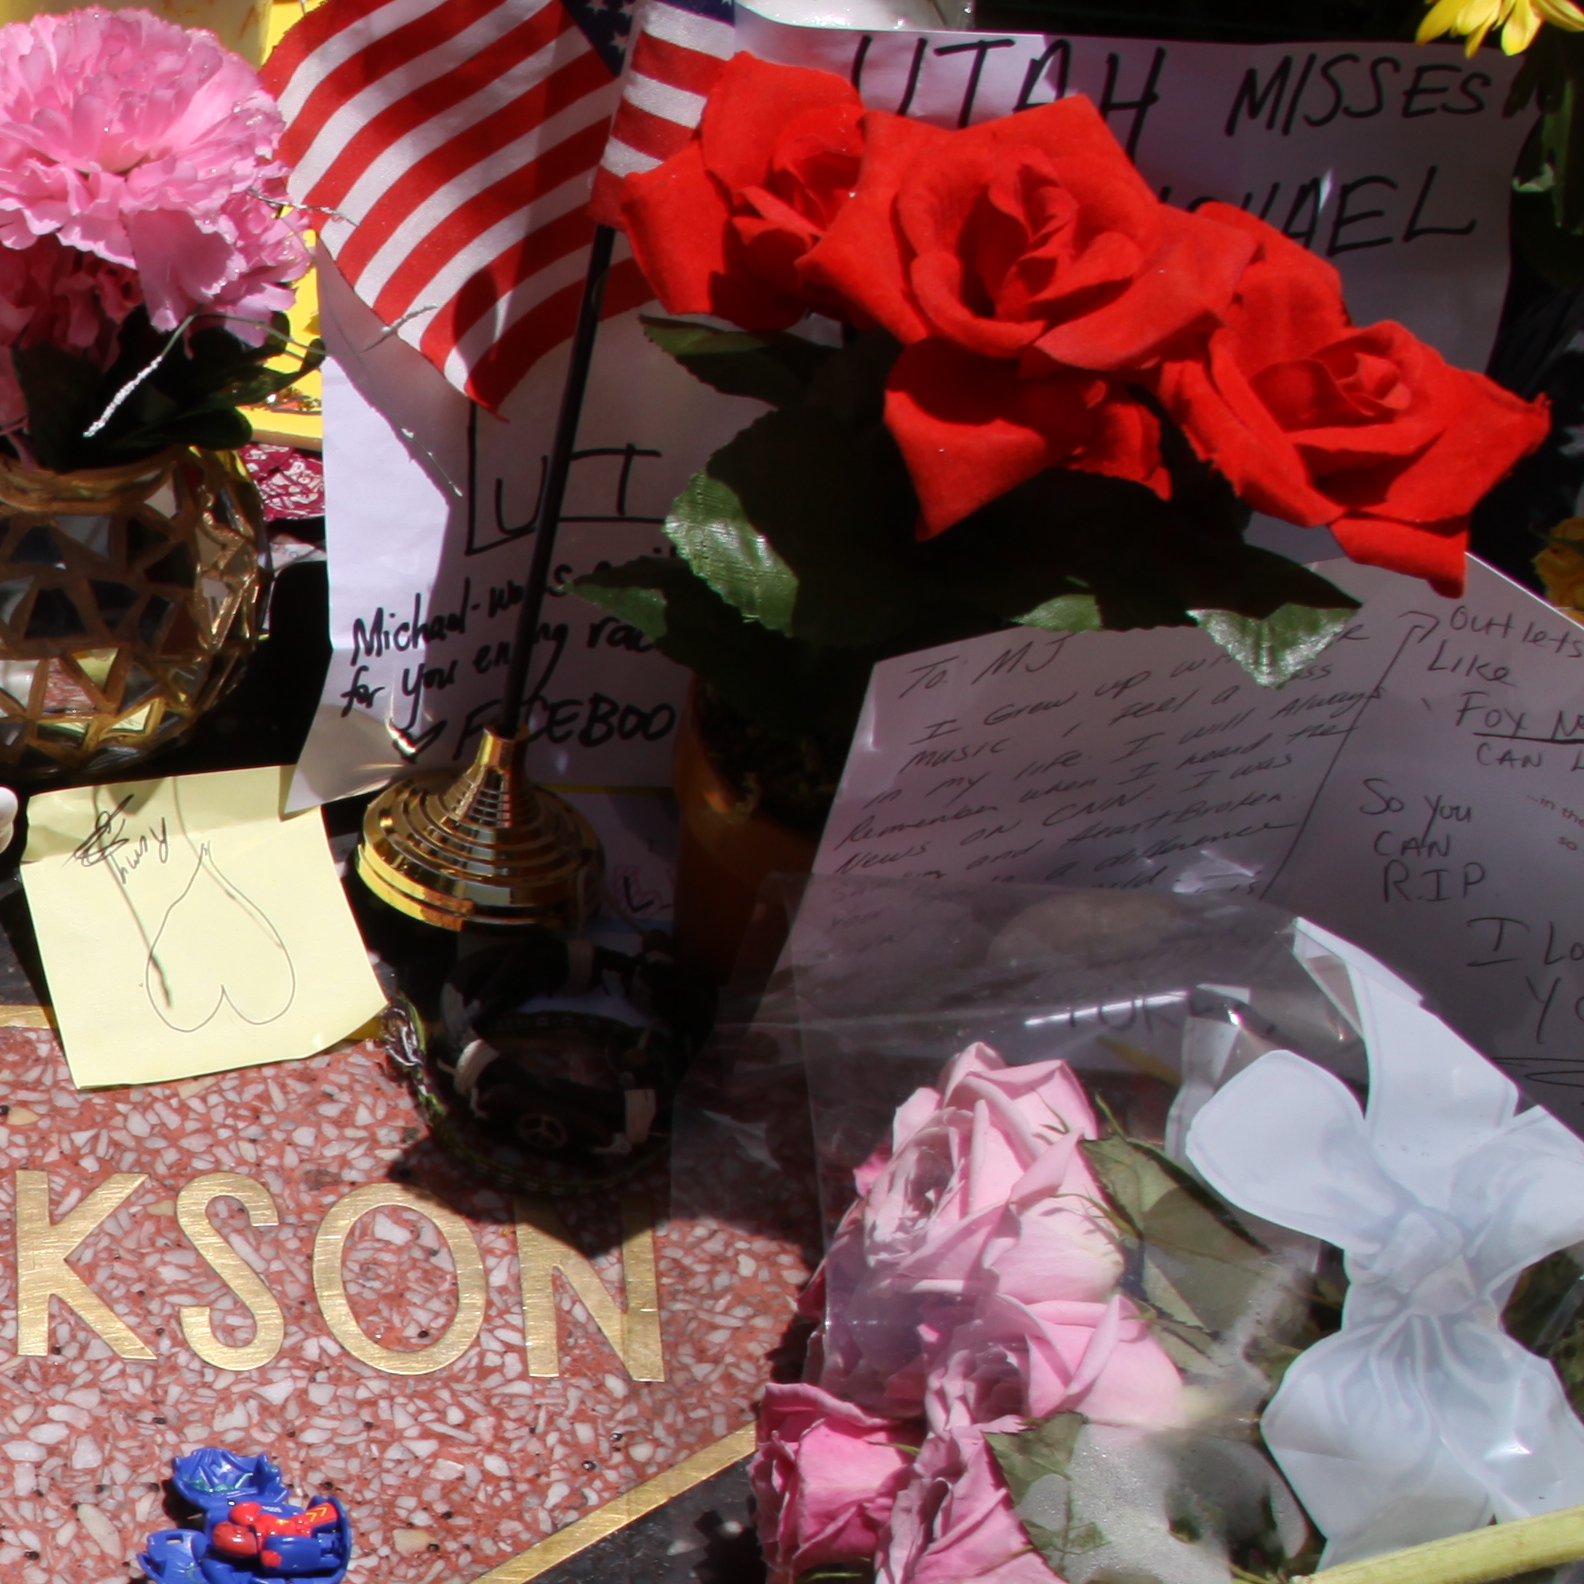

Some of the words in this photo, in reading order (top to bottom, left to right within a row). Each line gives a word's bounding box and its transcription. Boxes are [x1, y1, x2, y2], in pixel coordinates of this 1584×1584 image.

[1224, 52, 1493, 137] MISSES
[971, 632, 1088, 685] MJ
[340, 665, 385, 718] for
[401, 659, 459, 732] you
[1093, 669, 1151, 699] up
[928, 771, 982, 804] my
[1113, 731, 1165, 764] I
[1179, 706, 1256, 744] will
[1228, 753, 1296, 780] was
[1475, 740, 1543, 771] CAN
[963, 846, 1036, 872] and
[1372, 829, 1453, 859] CAN
[1465, 915, 1532, 968] I
